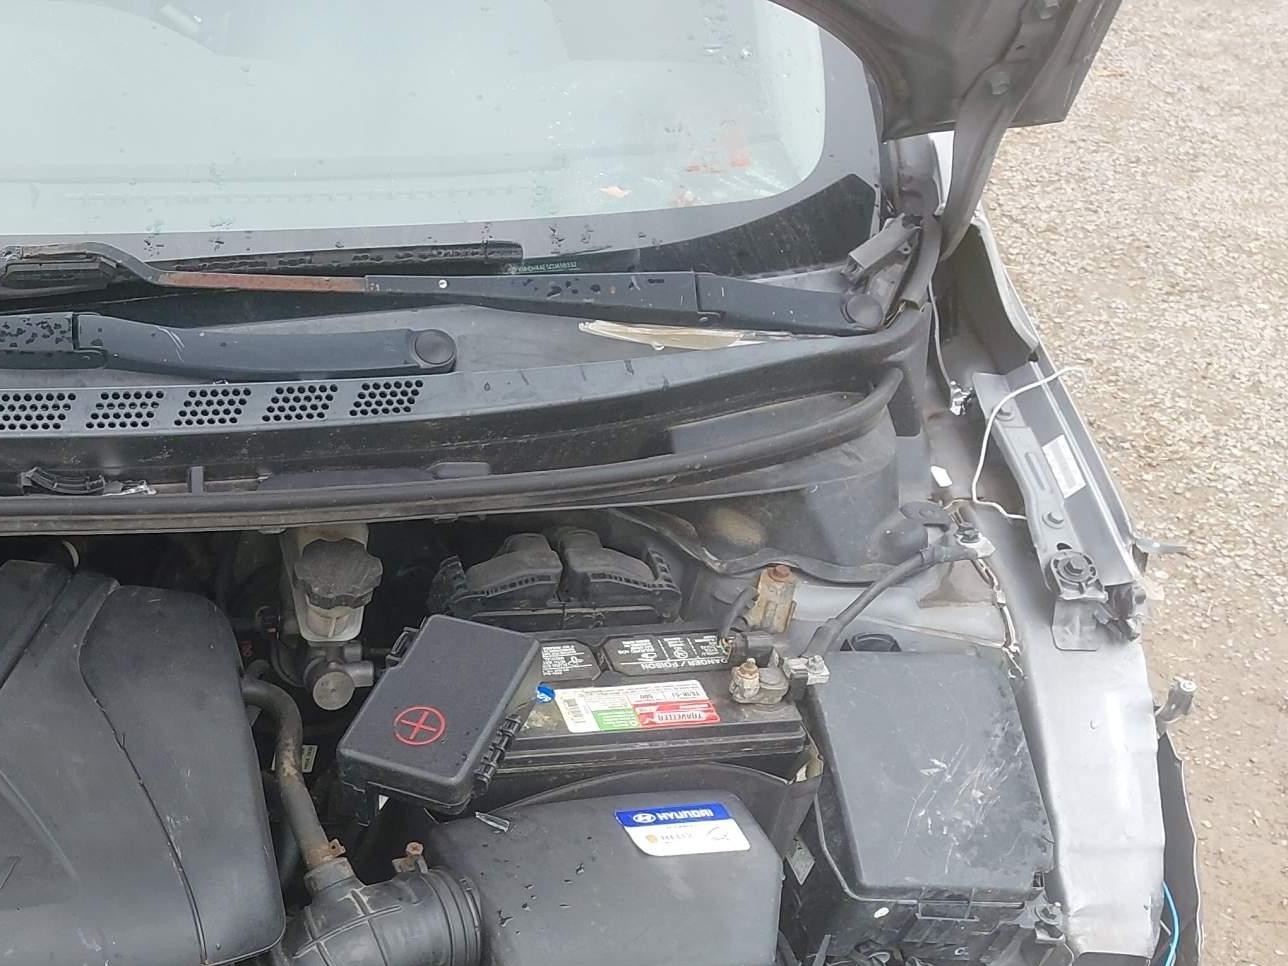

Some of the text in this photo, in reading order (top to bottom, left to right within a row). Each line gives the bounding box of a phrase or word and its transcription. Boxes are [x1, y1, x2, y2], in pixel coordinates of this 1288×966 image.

[640, 660, 680, 670] POISON
[688, 657, 728, 668] DANGER
[657, 711, 704, 722] TRAVELLER
[656, 808, 714, 821] HYUNDAI
